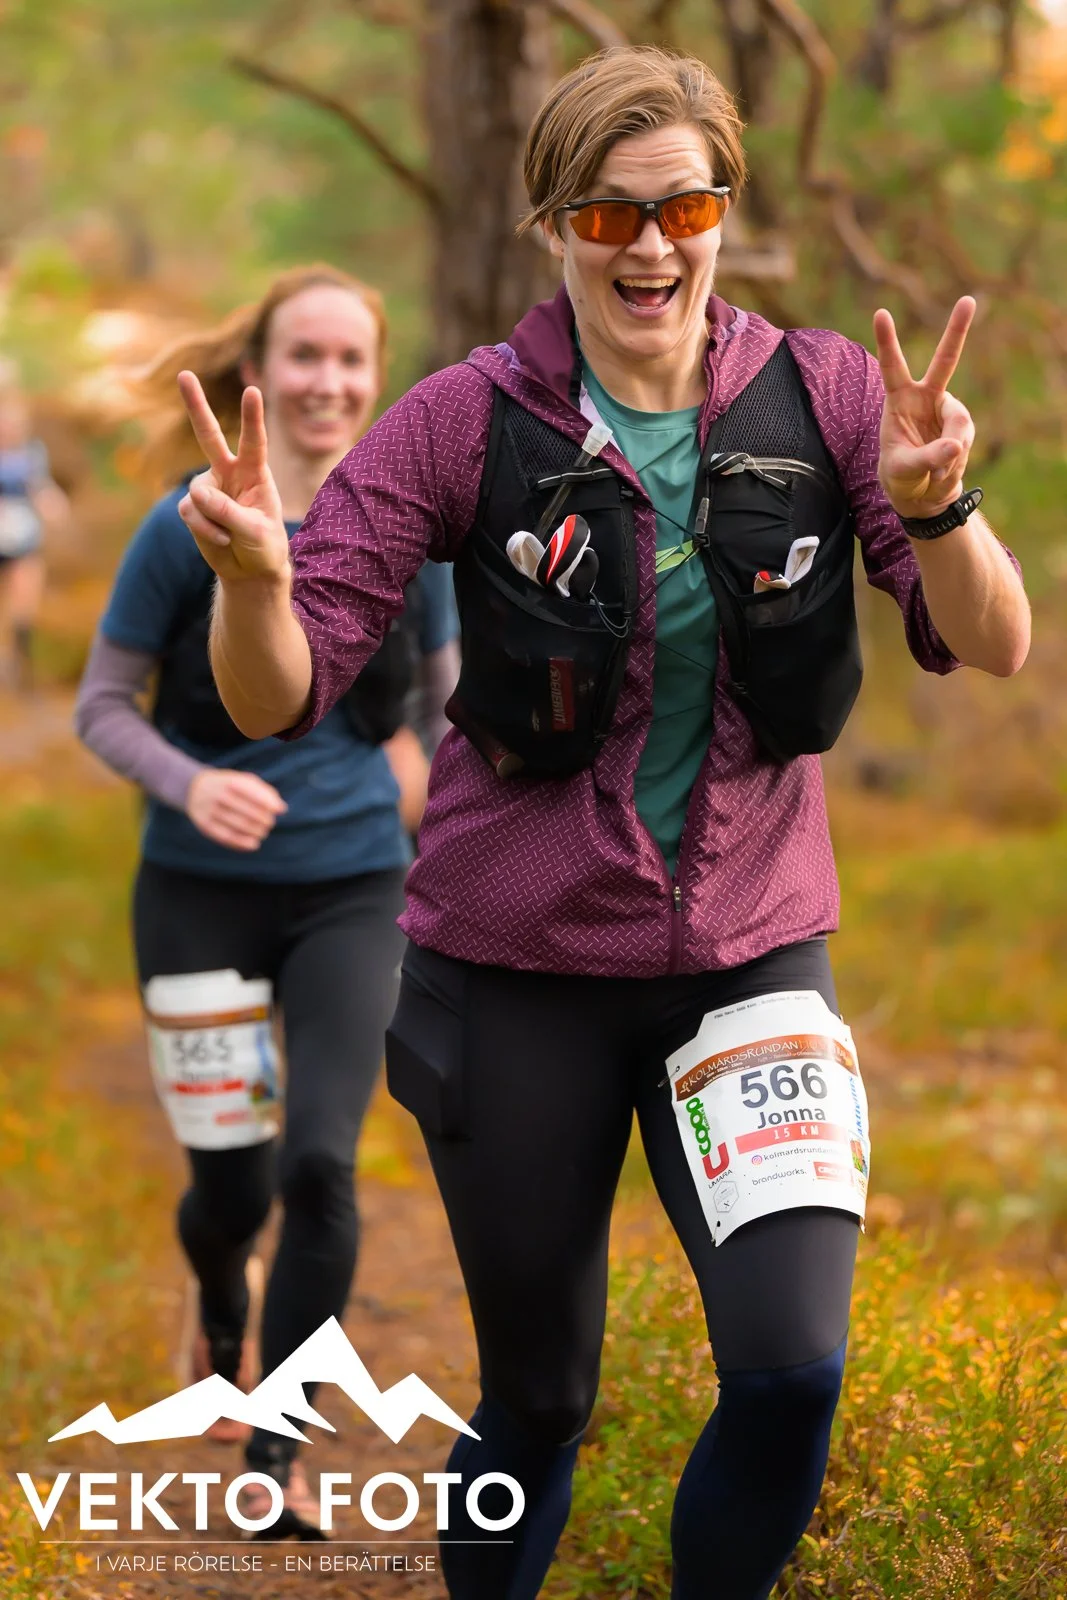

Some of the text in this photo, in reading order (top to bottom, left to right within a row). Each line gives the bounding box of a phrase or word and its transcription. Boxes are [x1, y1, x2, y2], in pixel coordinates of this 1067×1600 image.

[740, 1062, 828, 1109] 566
[685, 1097, 711, 1156] coop
[757, 1107, 825, 1129] Jonna
[774, 1125, 820, 1140] 15 KM
[708, 1169, 733, 1189] UMARA
